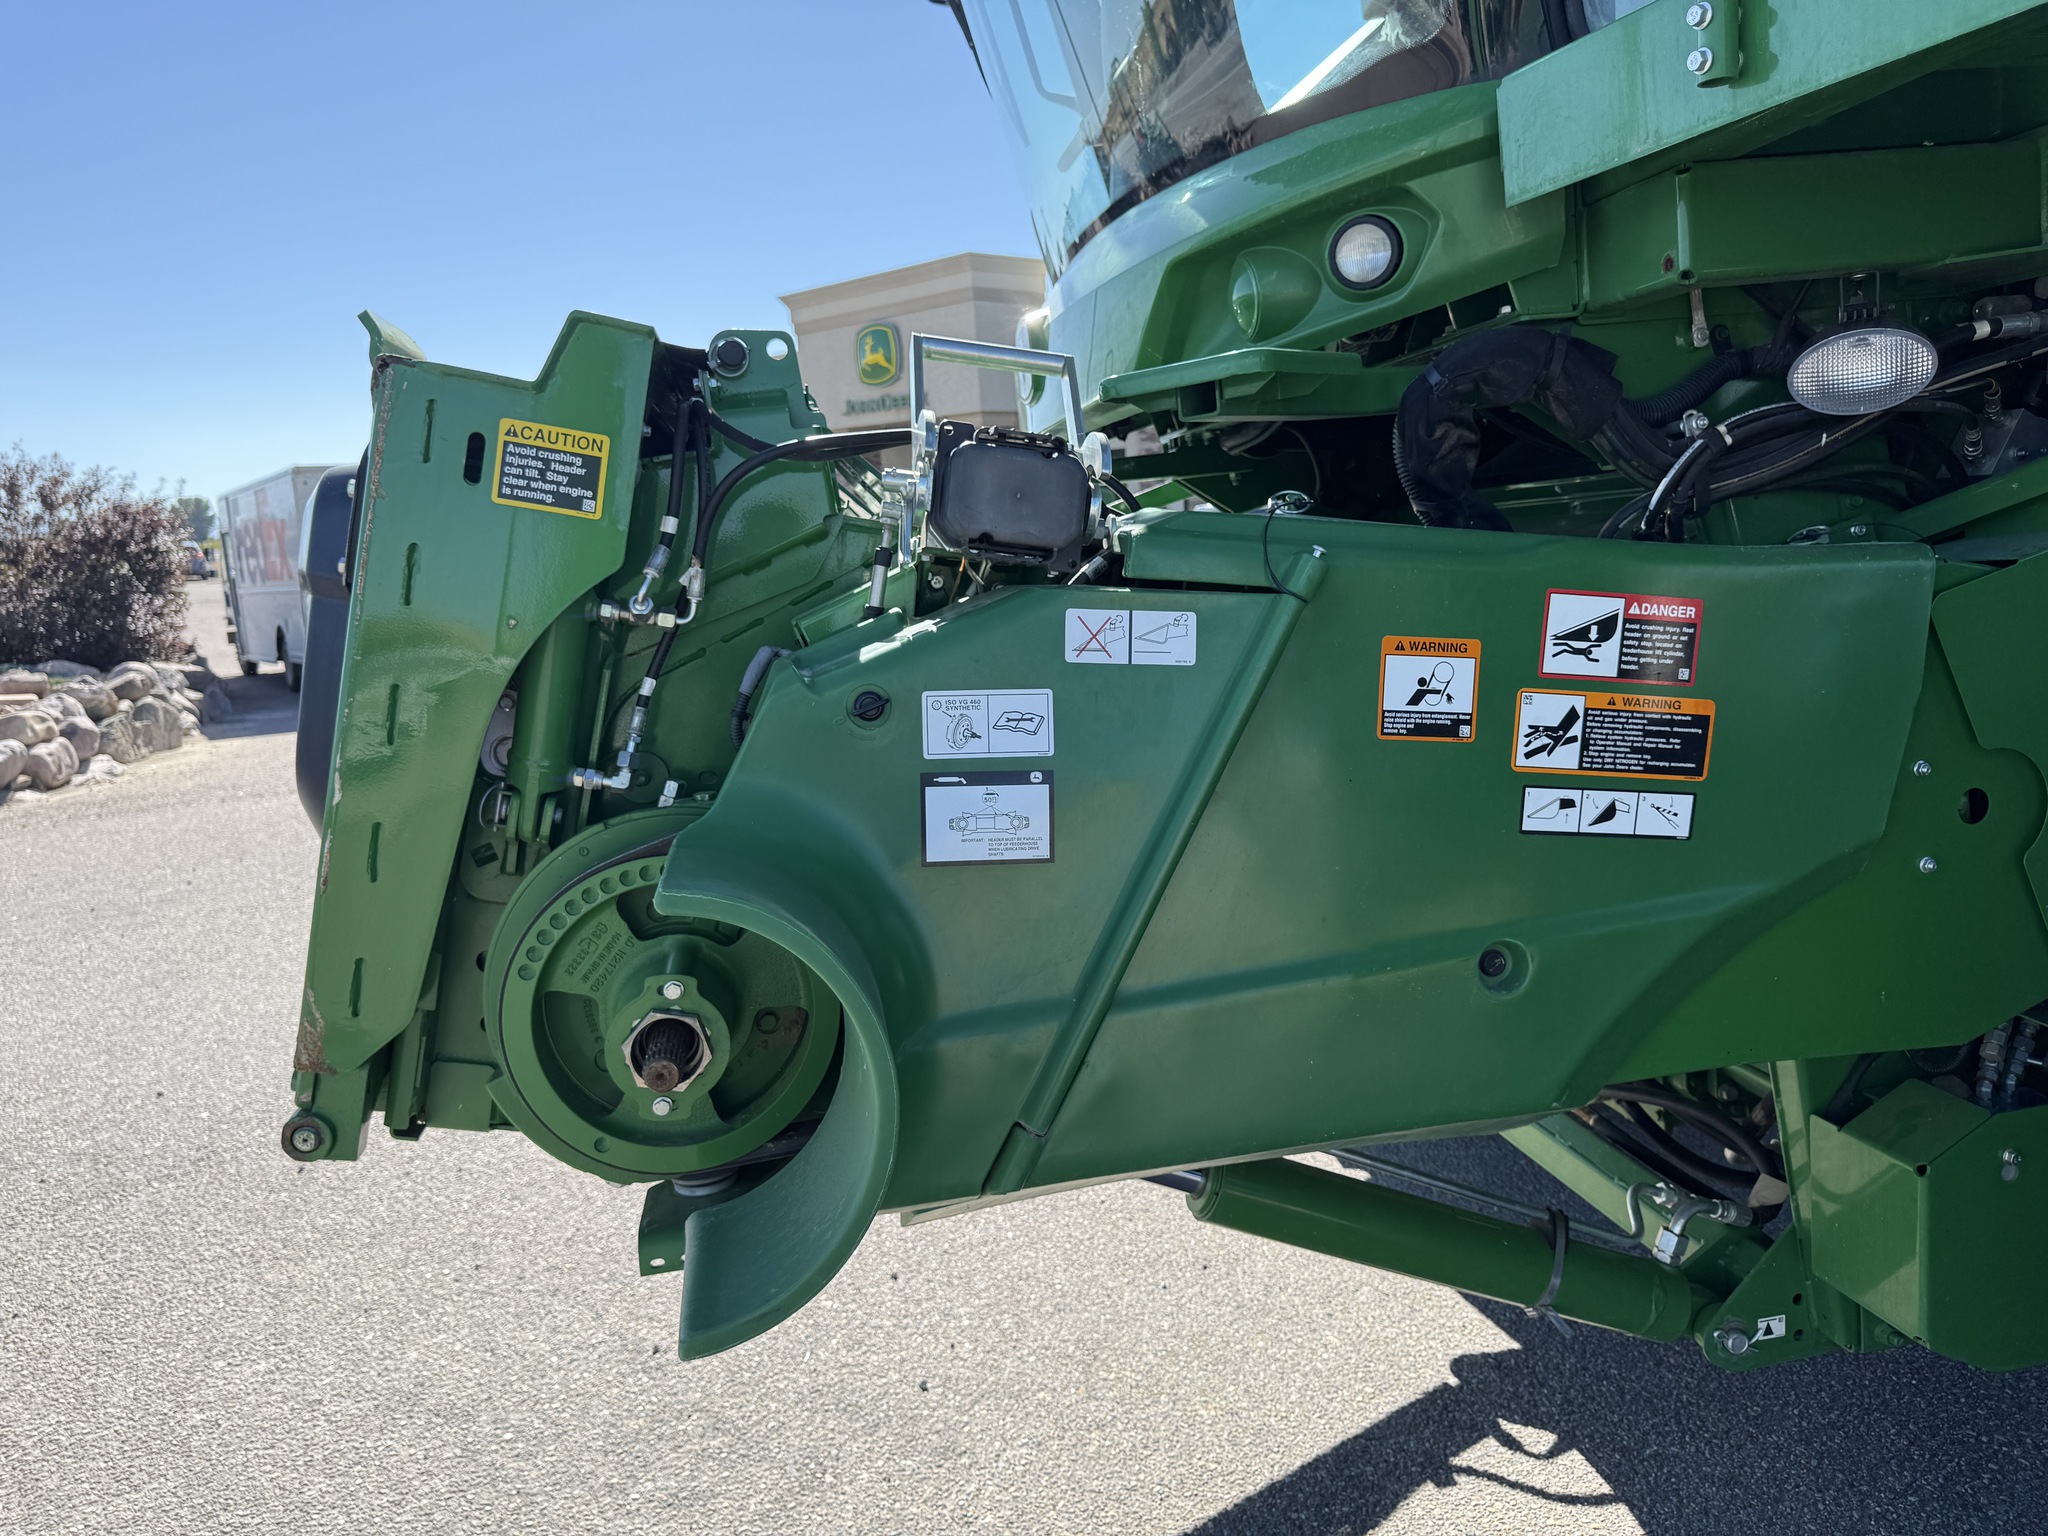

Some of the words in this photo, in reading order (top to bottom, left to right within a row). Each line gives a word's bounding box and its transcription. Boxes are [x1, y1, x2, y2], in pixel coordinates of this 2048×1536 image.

[520, 426, 604, 453] CAUTION
[507, 444, 536, 456] Avoid
[538, 450, 582, 466] crushing
[505, 455, 545, 468] injuries.
[551, 462, 586, 475] Header
[504, 466, 522, 475] can
[525, 468, 540, 478] tilt.
[546, 472, 568, 484] Stay
[502, 486, 511, 494] is
[513, 488, 555, 503] running.
[503, 476, 528, 487] clear
[530, 481, 557, 492] when
[559, 486, 593, 498] engine
[1642, 603, 1695, 618] DANGER
[1409, 641, 1468, 653] WARNING
[1623, 697, 1681, 710] WARNING
